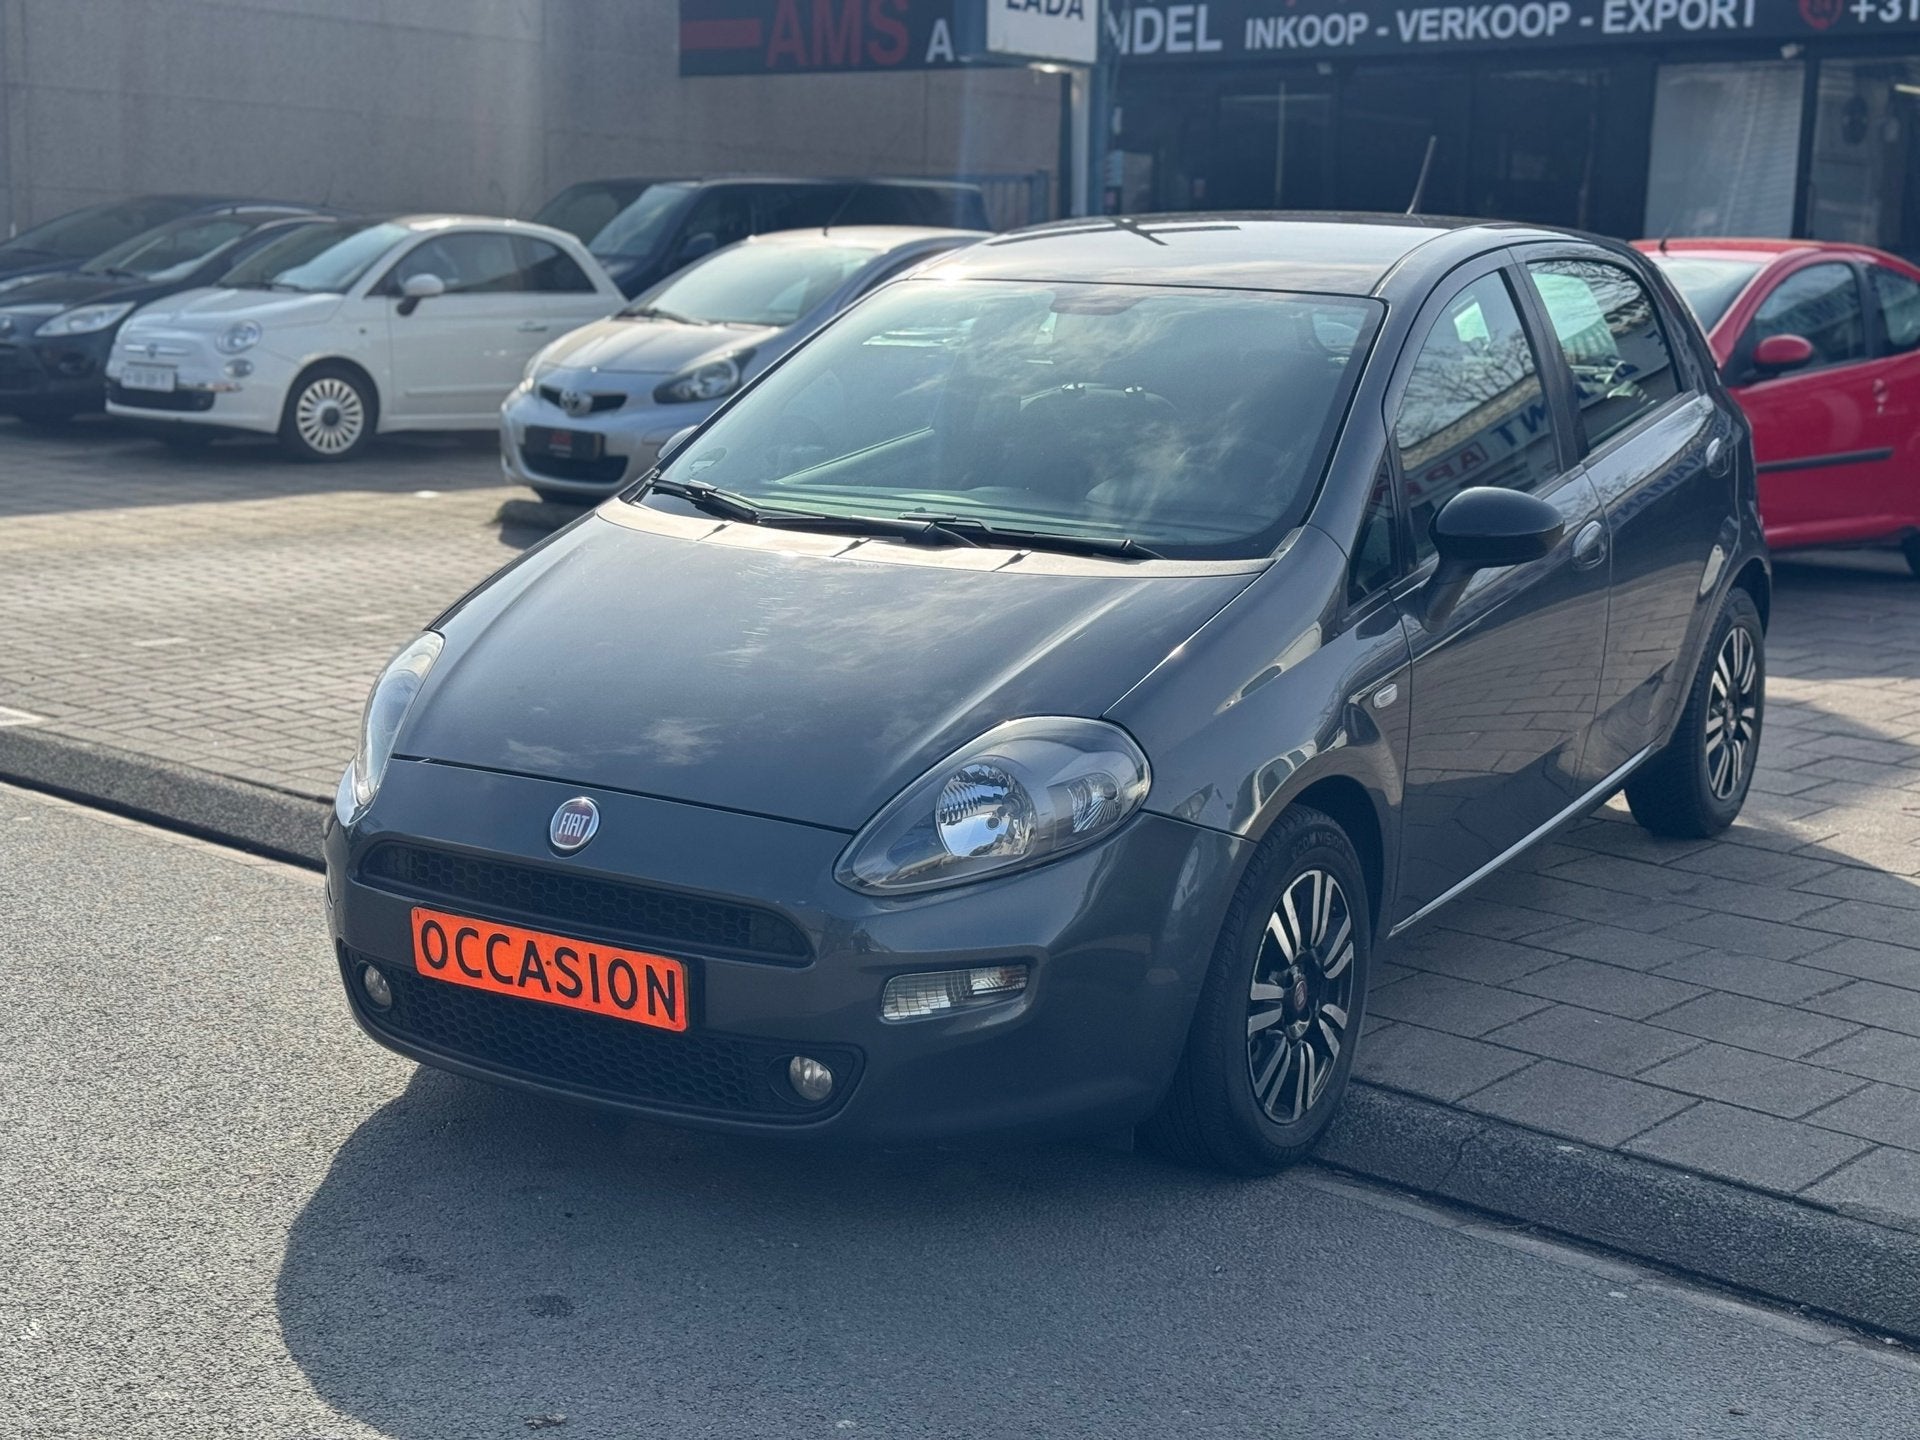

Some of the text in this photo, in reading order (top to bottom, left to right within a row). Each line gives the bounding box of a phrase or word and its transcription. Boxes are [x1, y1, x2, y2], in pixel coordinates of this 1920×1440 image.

[766, 0, 909, 67] AMS
[1245, 12, 1369, 50] INKOOP
[1396, 2, 1571, 43] VERKOOP
[1602, 0, 1756, 34] EXPORT
[558, 812, 590, 837] FIAT
[421, 919, 676, 1022] OCCASION
